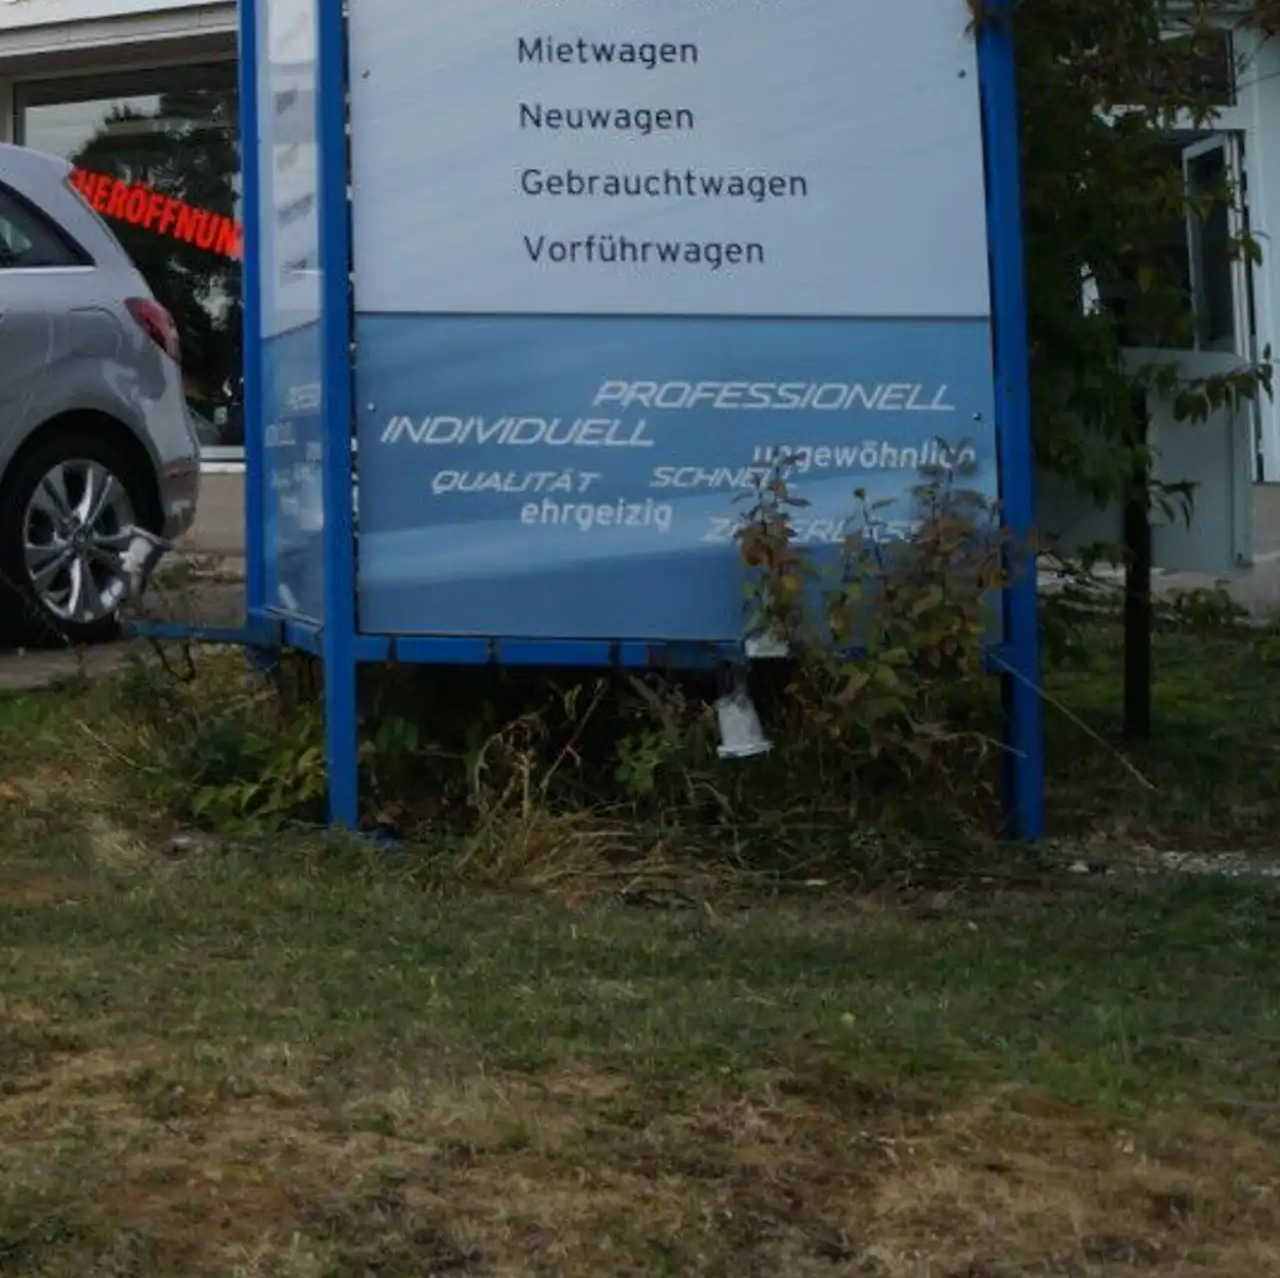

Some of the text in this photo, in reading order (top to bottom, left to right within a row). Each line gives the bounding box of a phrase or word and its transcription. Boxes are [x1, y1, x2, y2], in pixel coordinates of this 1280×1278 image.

[516, 36, 699, 69] Mietwagen
[518, 102, 695, 135] Neuwagen
[520, 168, 809, 203] Gebrauchtwagen
[523, 234, 765, 270] Vorführwagen
[591, 379, 955, 412] PROFESSIONELL
[380, 415, 656, 448] INDIVIDUELL
[430, 468, 602, 495] QUALITÄT
[520, 497, 674, 533] ehrgeizig
